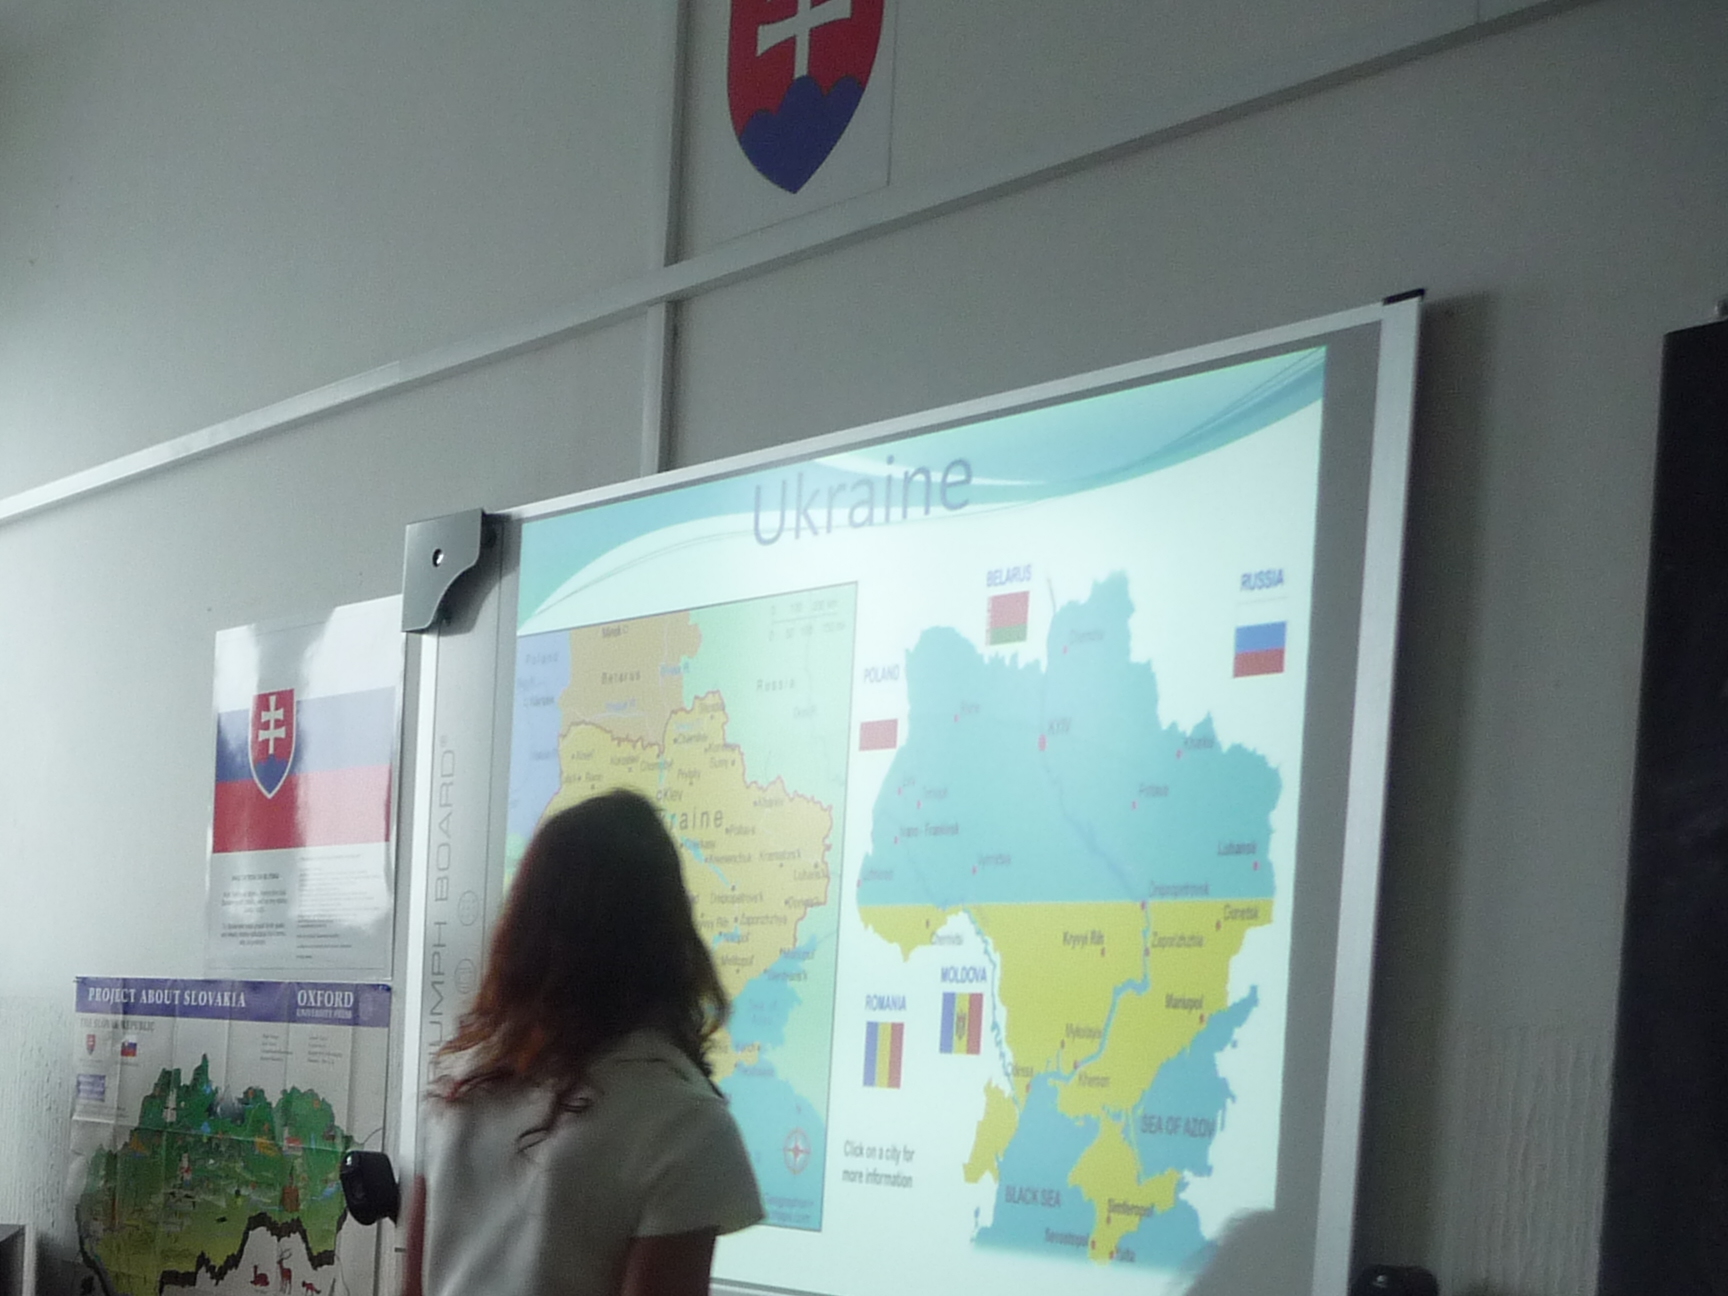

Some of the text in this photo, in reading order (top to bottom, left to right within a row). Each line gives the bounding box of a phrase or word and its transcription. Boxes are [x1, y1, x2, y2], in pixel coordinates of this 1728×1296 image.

[753, 454, 973, 547] Ukraine
[986, 563, 1032, 587] BELARUS
[1240, 568, 1285, 592] RUSSIA
[756, 678, 797, 693] Russia
[863, 664, 900, 684] POLAND
[427, 748, 456, 1086] RIUMPH BOARD
[940, 965, 988, 984] MOLDOVA
[88, 986, 247, 1008] PROJECT ABOUT SLOVAKIA
[297, 989, 354, 1009] OXFORD
[865, 994, 908, 1012] ROMANIA
[296, 1008, 332, 1019] UNIVERSITY
[1140, 1113, 1217, 1139] SEA OF AZOV
[843, 1139, 864, 1159] Click
[865, 1145, 877, 1159] on
[885, 1144, 902, 1166] city
[903, 1144, 916, 1163] for
[842, 1166, 914, 1189] more information
[1004, 1184, 1062, 1209] BLACK SEA
